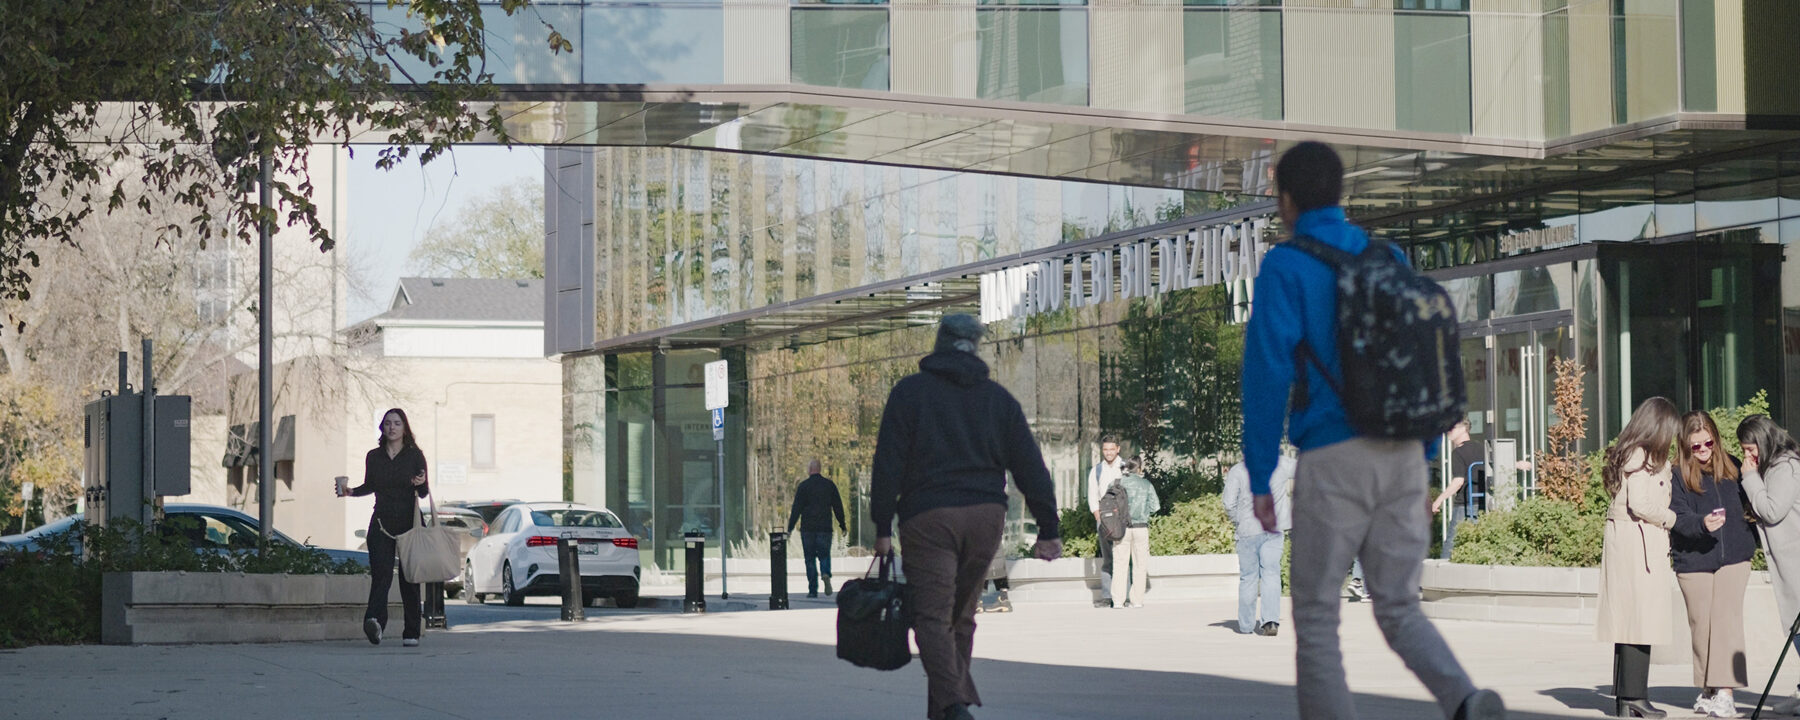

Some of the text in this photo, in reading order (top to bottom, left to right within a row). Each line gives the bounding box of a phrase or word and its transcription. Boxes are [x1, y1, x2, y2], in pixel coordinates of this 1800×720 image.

[1515, 229, 1542, 249] ELGIN
[1541, 223, 1576, 245] AVENUE
[981, 259, 1064, 324] MANITOU
[1070, 254, 1086, 308] A
[1091, 249, 1113, 304] BI
[1120, 242, 1151, 299] BII
